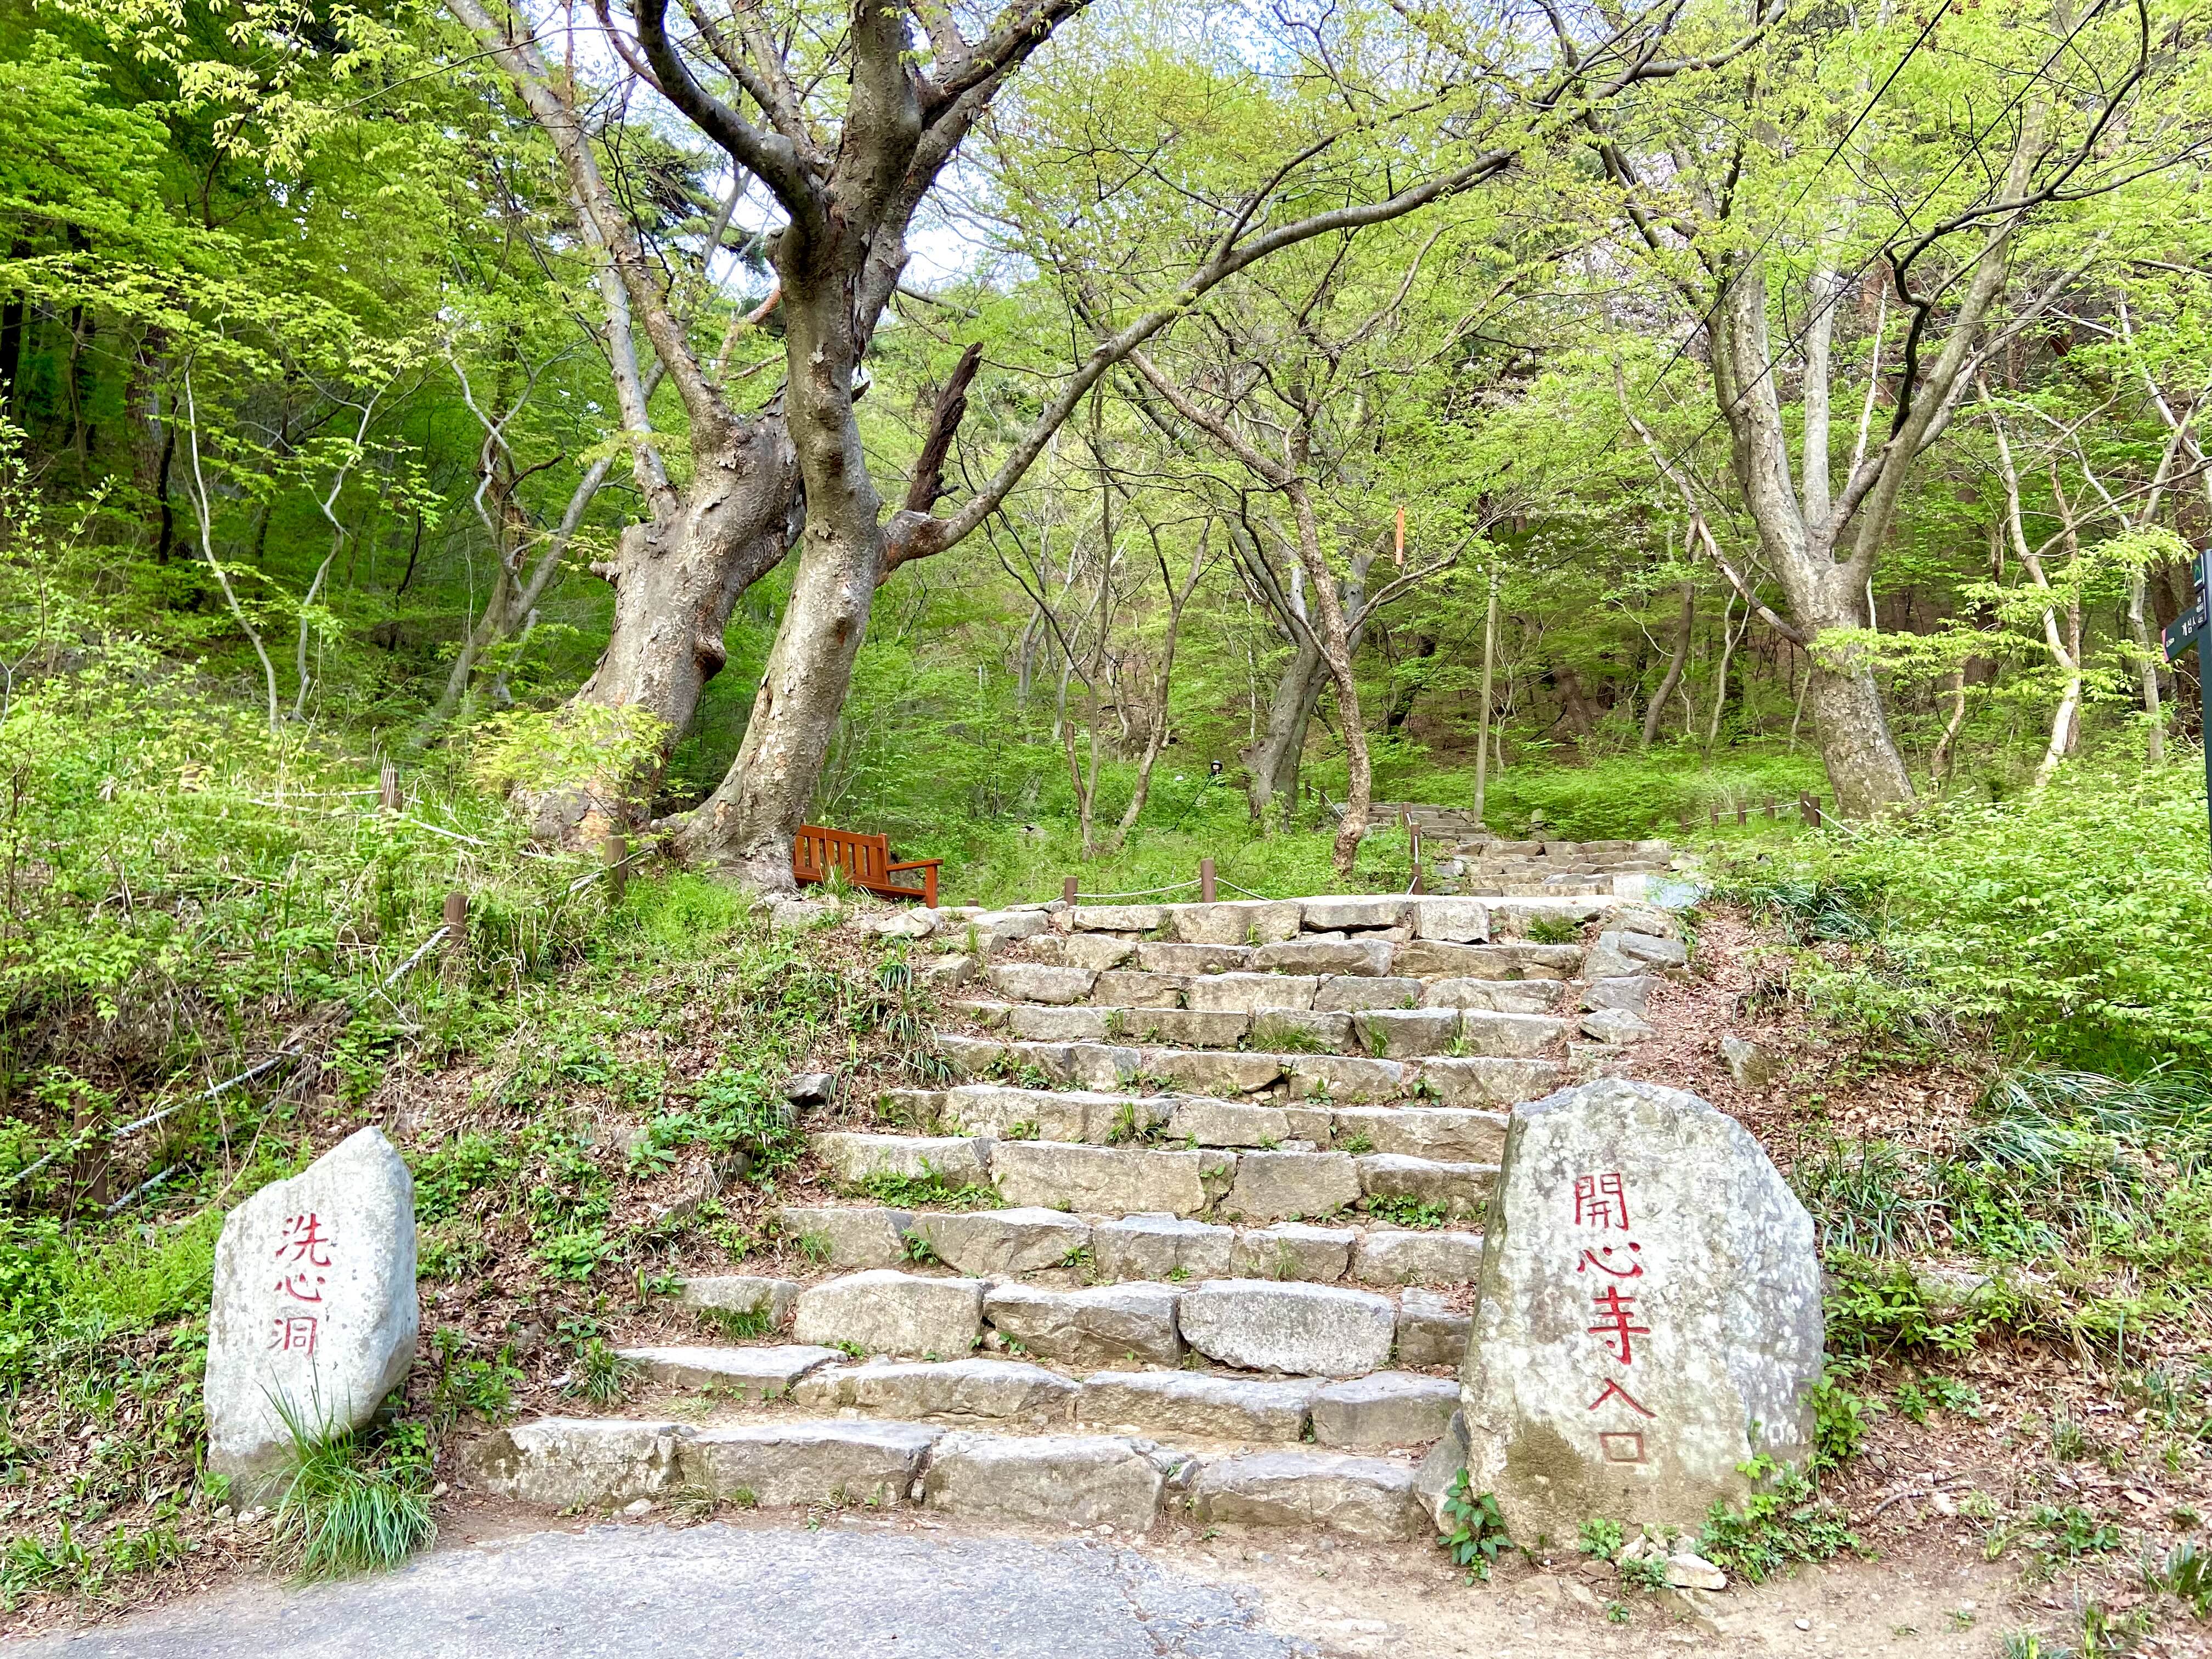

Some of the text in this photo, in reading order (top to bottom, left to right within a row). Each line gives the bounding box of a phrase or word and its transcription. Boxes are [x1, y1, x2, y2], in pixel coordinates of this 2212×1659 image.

[268, 1212, 332, 1360] 洗心洞
[1575, 1171, 1656, 1464] 開心寺入口
